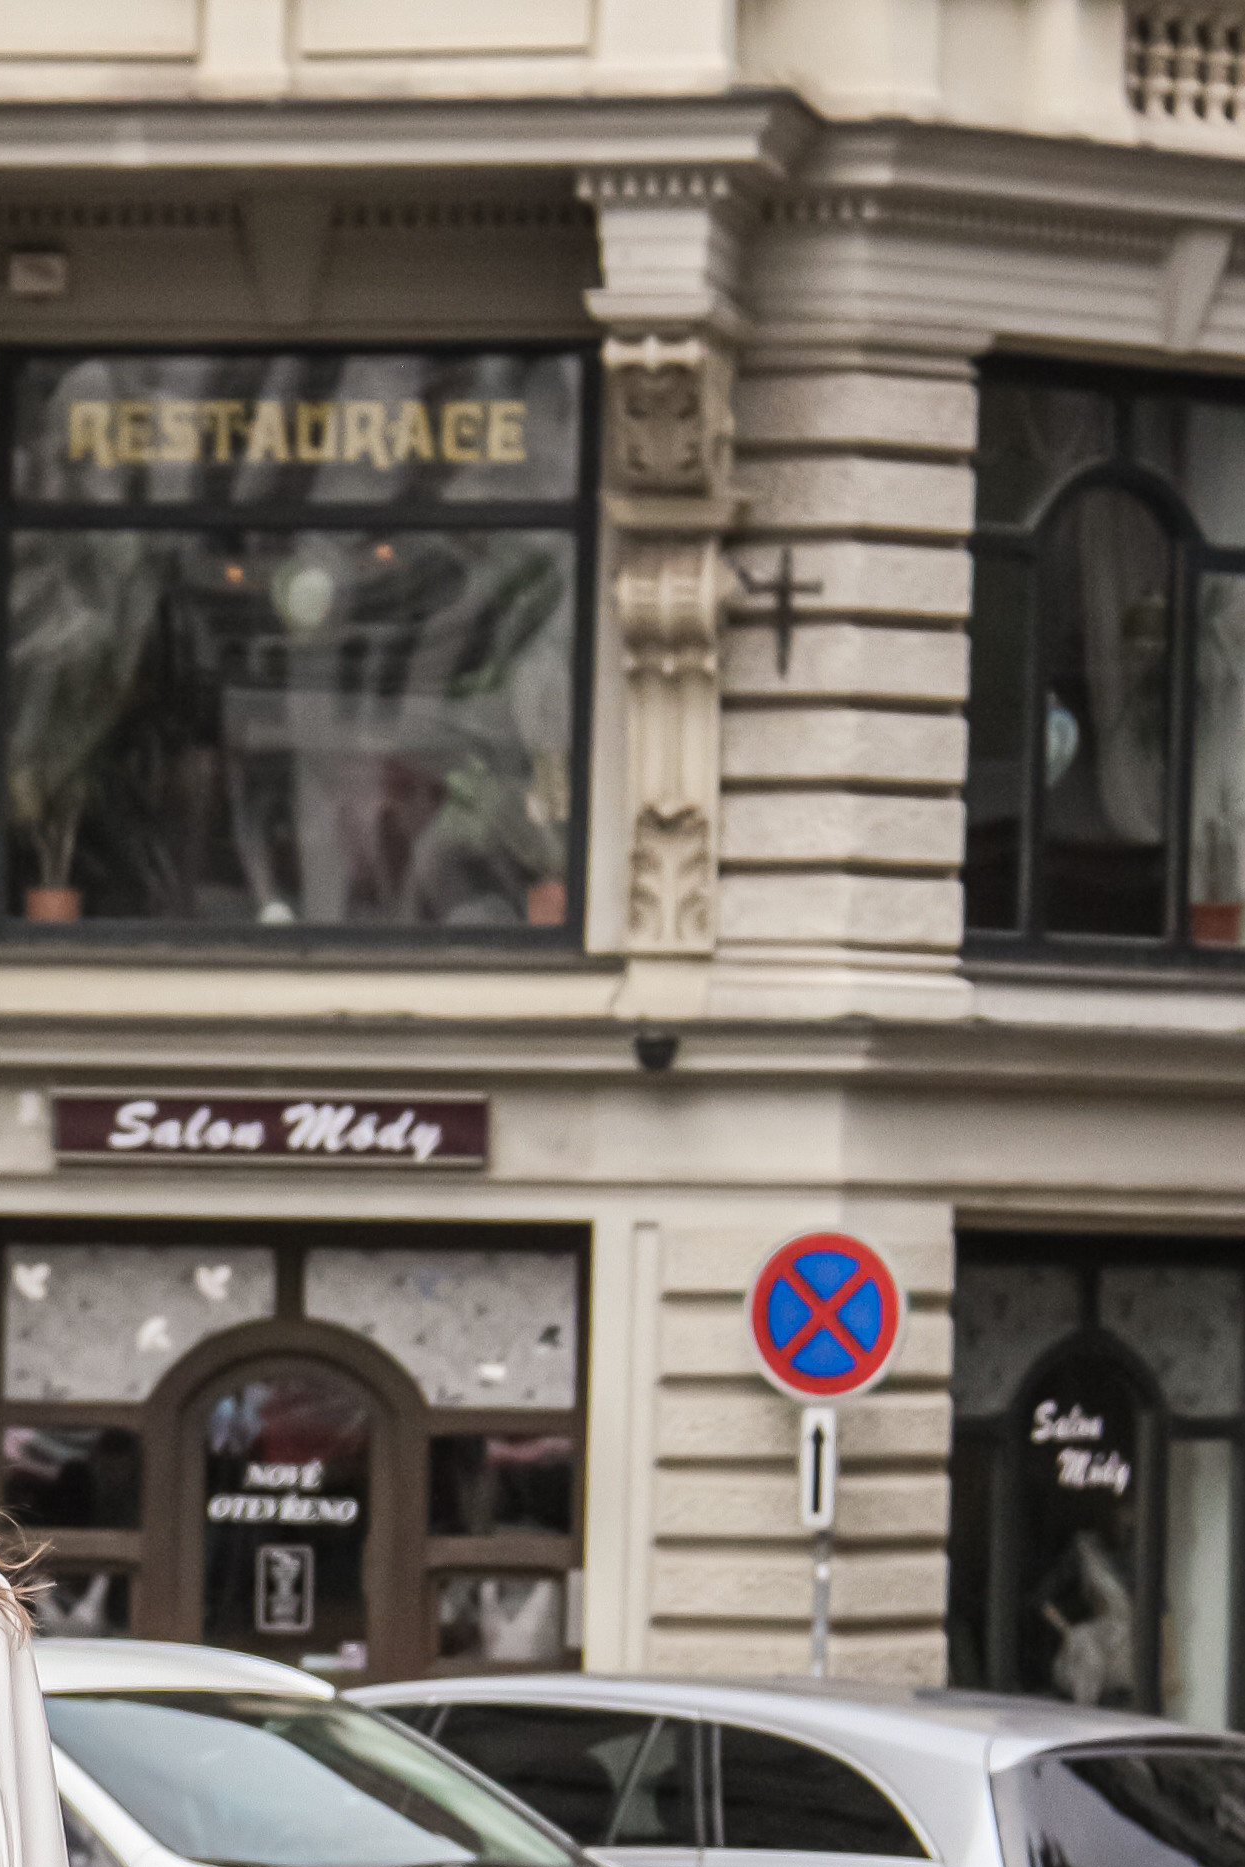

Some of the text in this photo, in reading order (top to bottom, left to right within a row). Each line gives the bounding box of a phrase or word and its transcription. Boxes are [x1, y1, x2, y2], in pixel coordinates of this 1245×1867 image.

[67, 400, 528, 468] RESTAURACE
[107, 1100, 265, 1149] Salon
[1029, 1399, 1104, 1444] Salon
